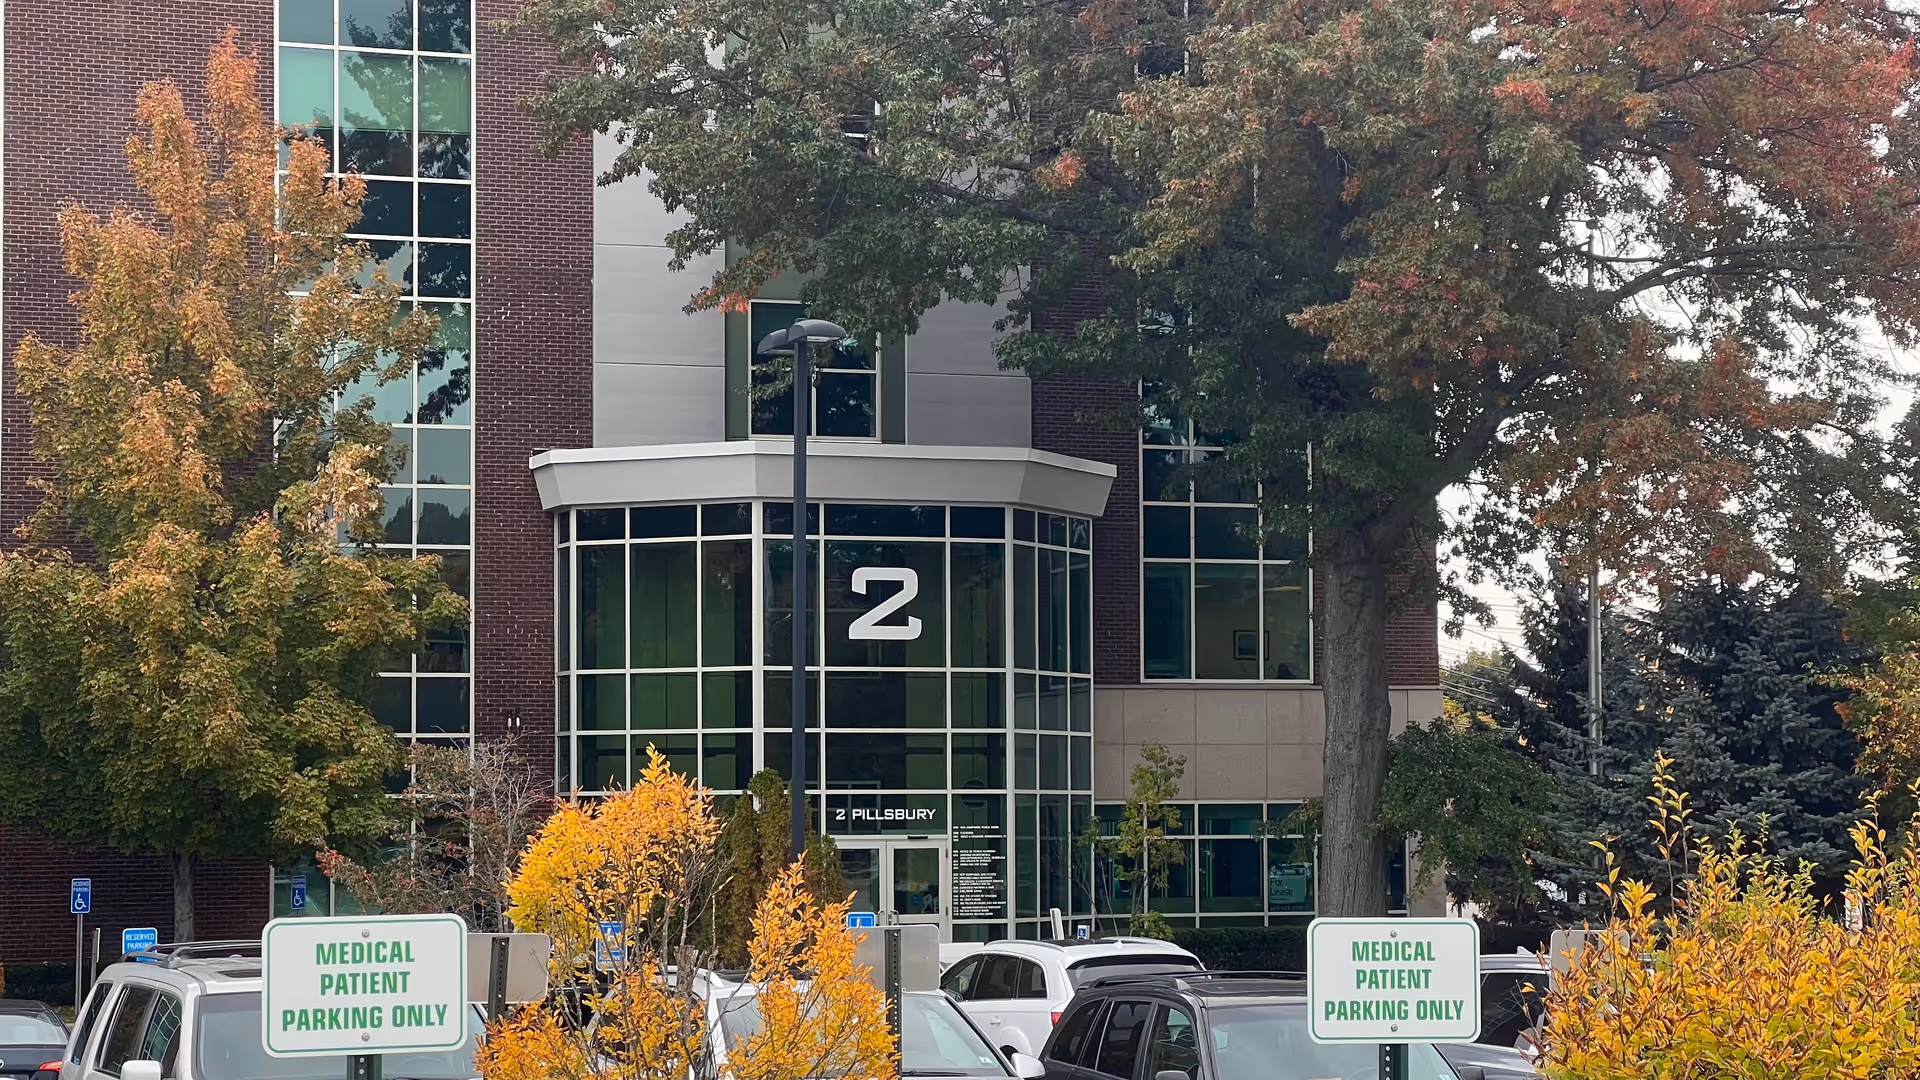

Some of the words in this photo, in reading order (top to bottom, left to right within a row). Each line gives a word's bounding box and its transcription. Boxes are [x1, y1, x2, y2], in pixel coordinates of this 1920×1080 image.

[848, 566, 923, 641] 2
[835, 808, 846, 821] 2
[852, 808, 937, 821] PILLSBURY
[126, 933, 155, 941] RESERVED
[315, 940, 416, 966] MEDICAL
[1351, 940, 1435, 962] MEDICAL
[320, 970, 411, 996] PATIENT
[1355, 968, 1431, 990] PATIENT
[281, 1005, 383, 1032] PARKING
[391, 1003, 448, 1028] ONLY
[1324, 1000, 1409, 1020] PARKING
[1415, 1000, 1464, 1020] ONLY
